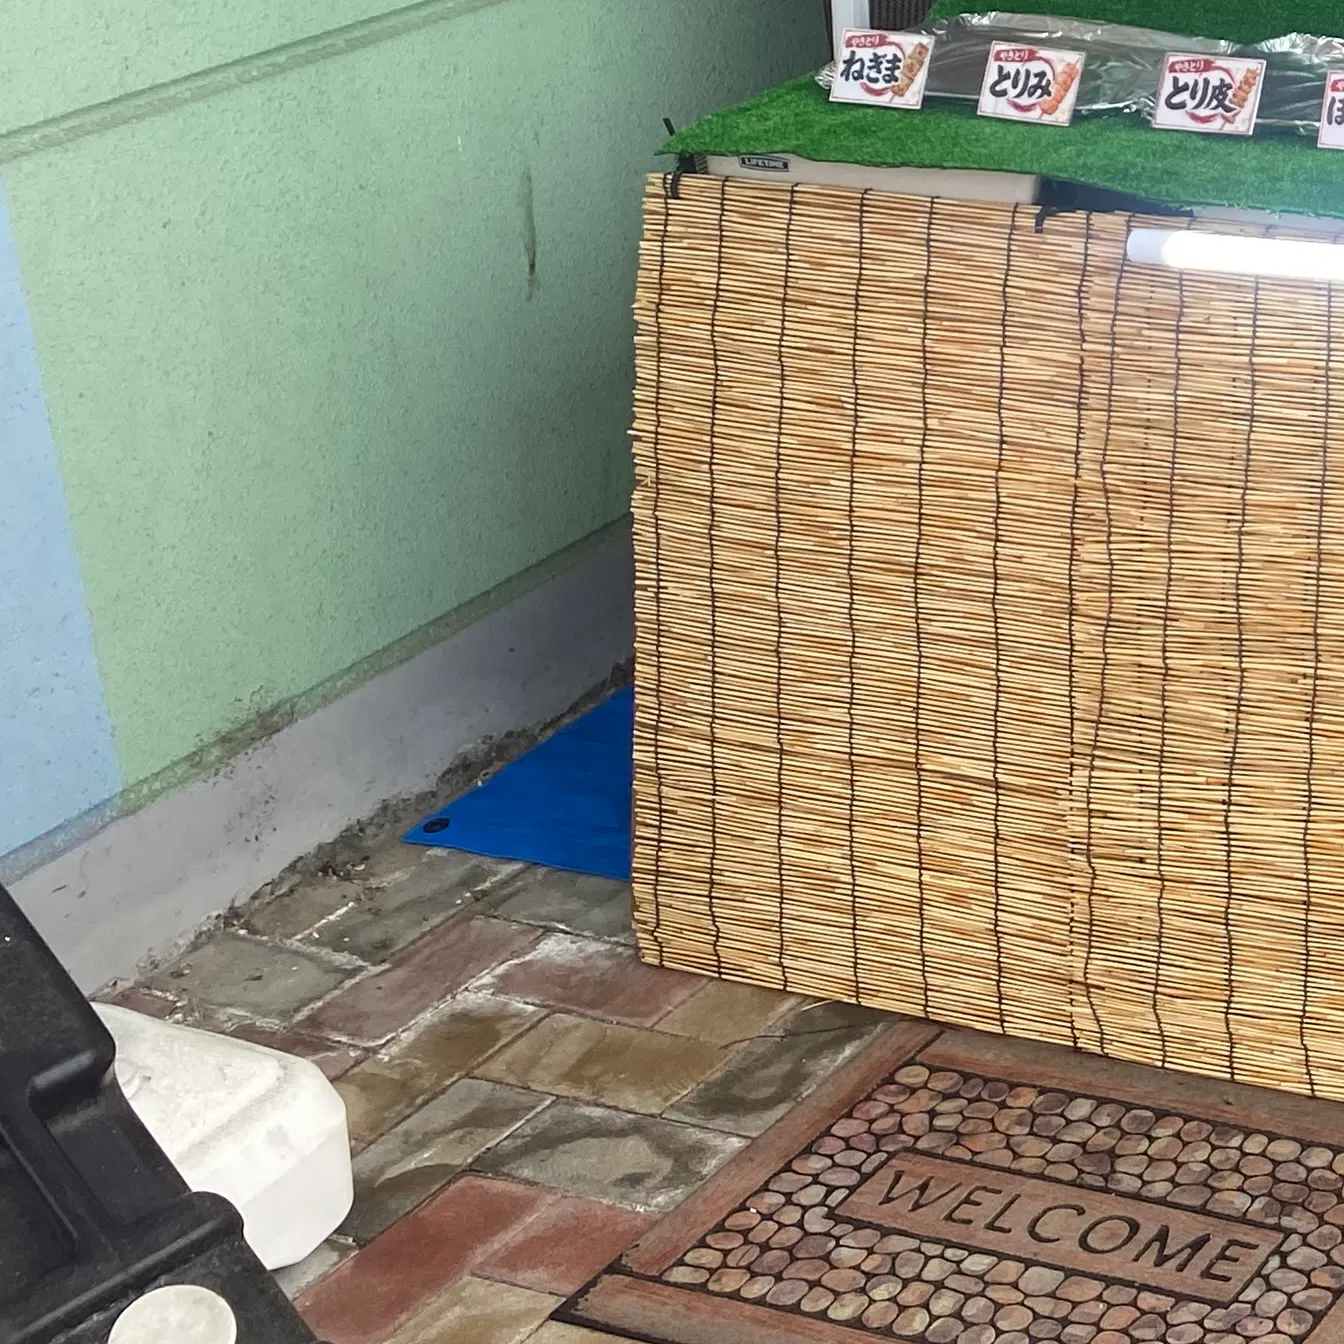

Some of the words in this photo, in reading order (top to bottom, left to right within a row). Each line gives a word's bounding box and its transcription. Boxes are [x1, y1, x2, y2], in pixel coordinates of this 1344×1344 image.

[840, 50, 903, 84] ねぎま
[987, 64, 1053, 103] とりみ
[1163, 75, 1238, 115] とり皮
[878, 1169, 1260, 1283] WELCOME
